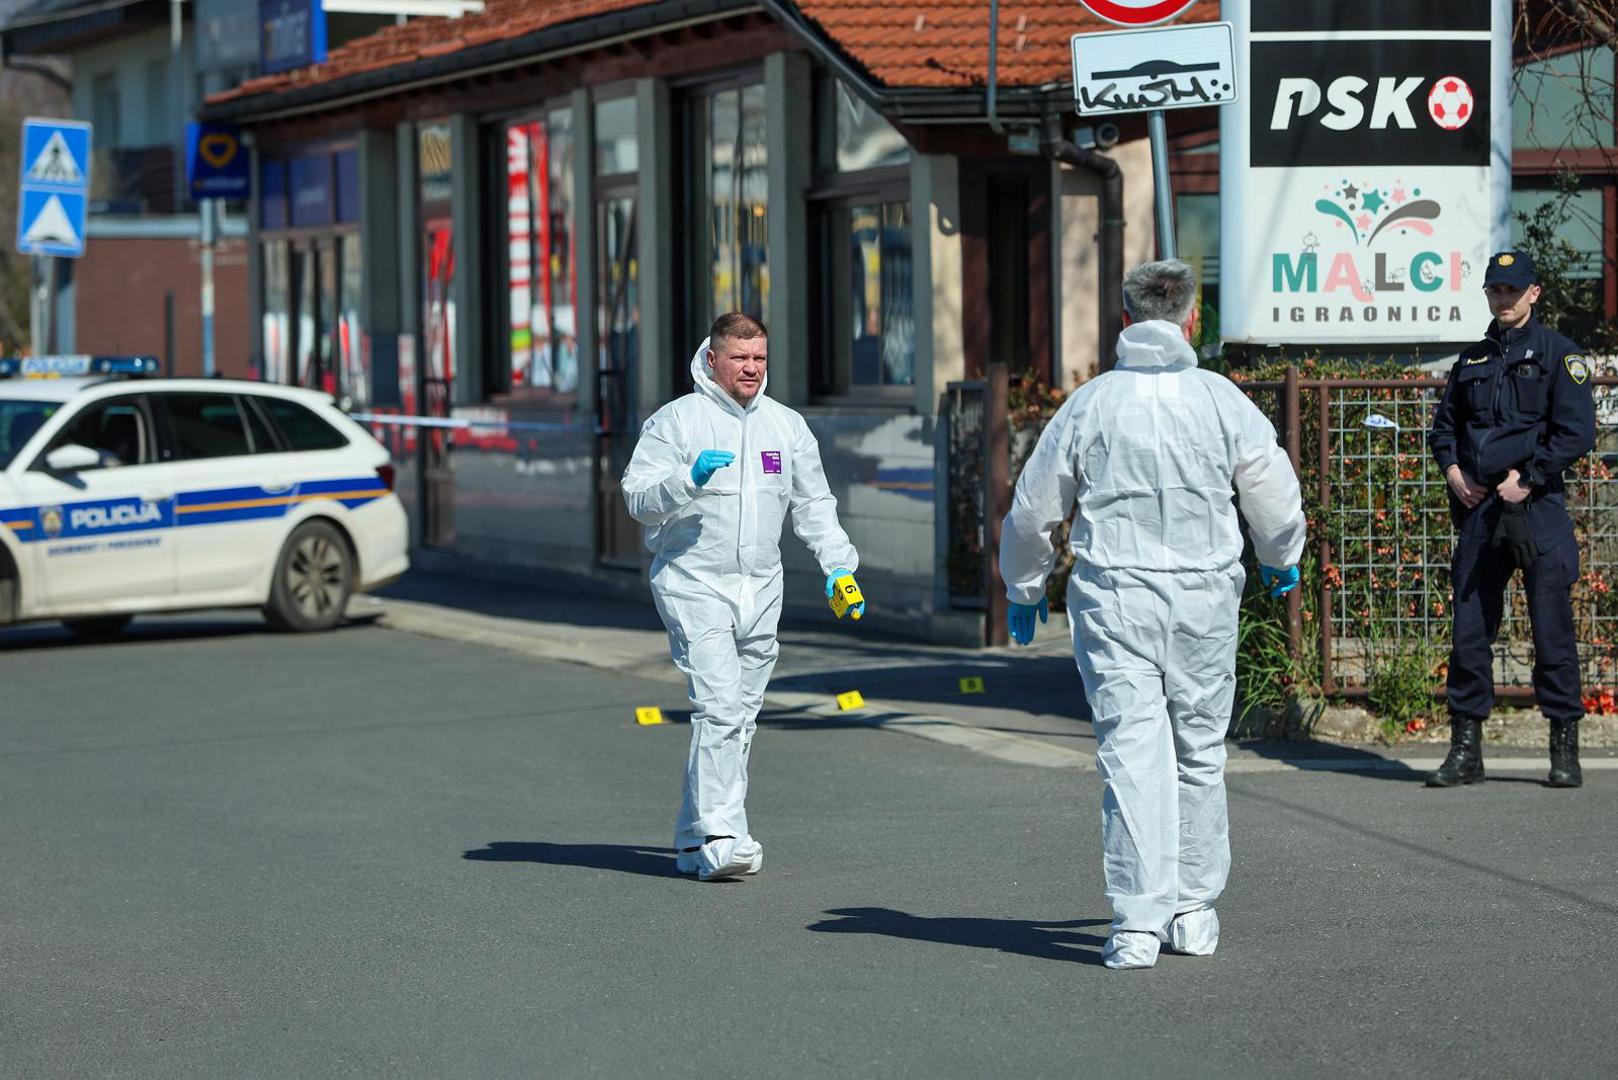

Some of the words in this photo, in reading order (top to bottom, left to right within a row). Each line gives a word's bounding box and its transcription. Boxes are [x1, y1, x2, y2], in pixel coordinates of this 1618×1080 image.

[1270, 75, 1426, 131] PSK
[1272, 251, 1462, 303] MALCI
[1272, 306, 1462, 322] IGRAONICA
[70, 502, 162, 530] POLICIJA
